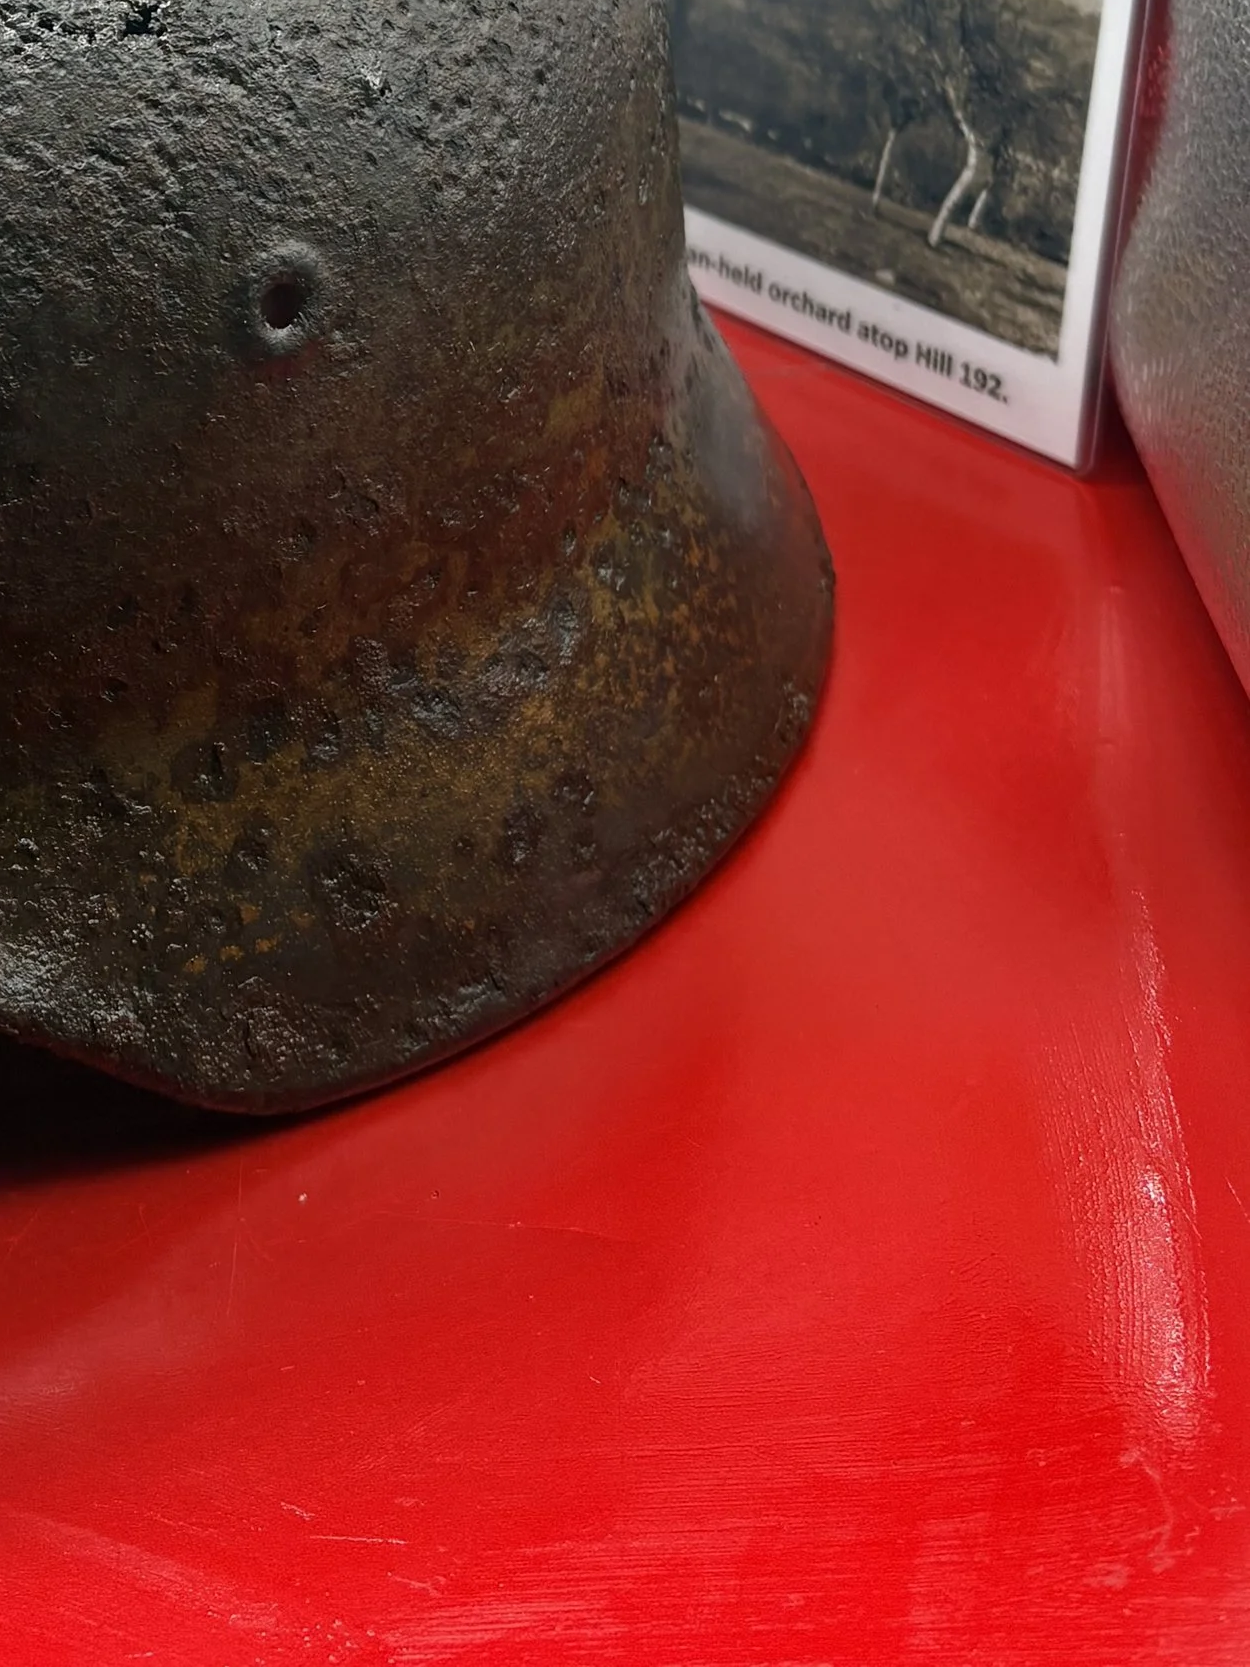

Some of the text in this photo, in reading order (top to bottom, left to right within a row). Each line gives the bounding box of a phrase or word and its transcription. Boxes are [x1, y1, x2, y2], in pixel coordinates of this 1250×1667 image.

[768, 278, 852, 333] orchard
[856, 316, 909, 359] atop
[914, 342, 954, 378] Hill
[958, 361, 1009, 405] 192.
